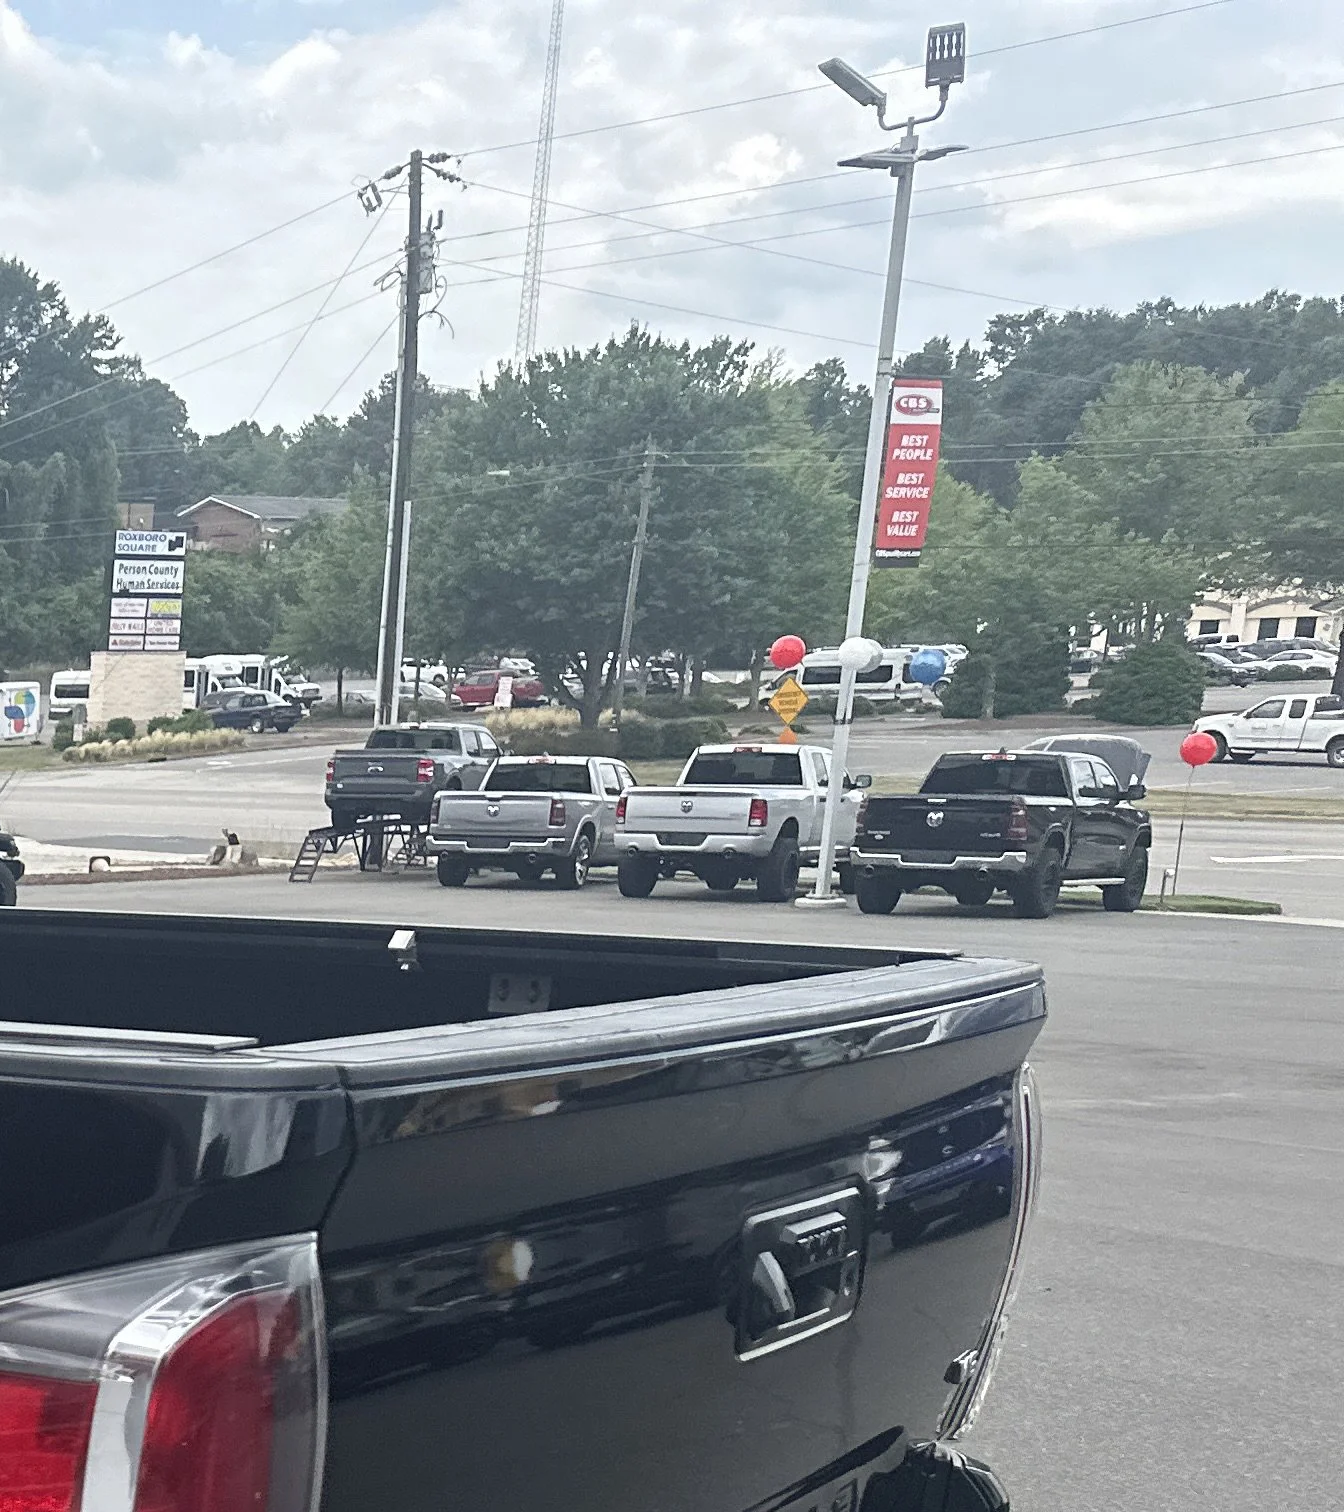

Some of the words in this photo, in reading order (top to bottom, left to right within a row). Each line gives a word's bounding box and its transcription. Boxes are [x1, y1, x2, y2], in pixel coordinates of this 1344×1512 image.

[899, 397, 927, 408] CBS
[901, 435, 929, 447] BEST
[892, 449, 933, 461] PEOPLE
[897, 473, 924, 485] BEST
[885, 486, 930, 499] SERVICE
[891, 511, 919, 523] BEST
[886, 524, 919, 537] VALUE
[118, 532, 167, 542] ROXBORO
[117, 543, 157, 552] SQUARE
[118, 563, 147, 575] Person
[148, 564, 179, 578] County
[116, 578, 145, 590] Human
[146, 578, 180, 590] Services
